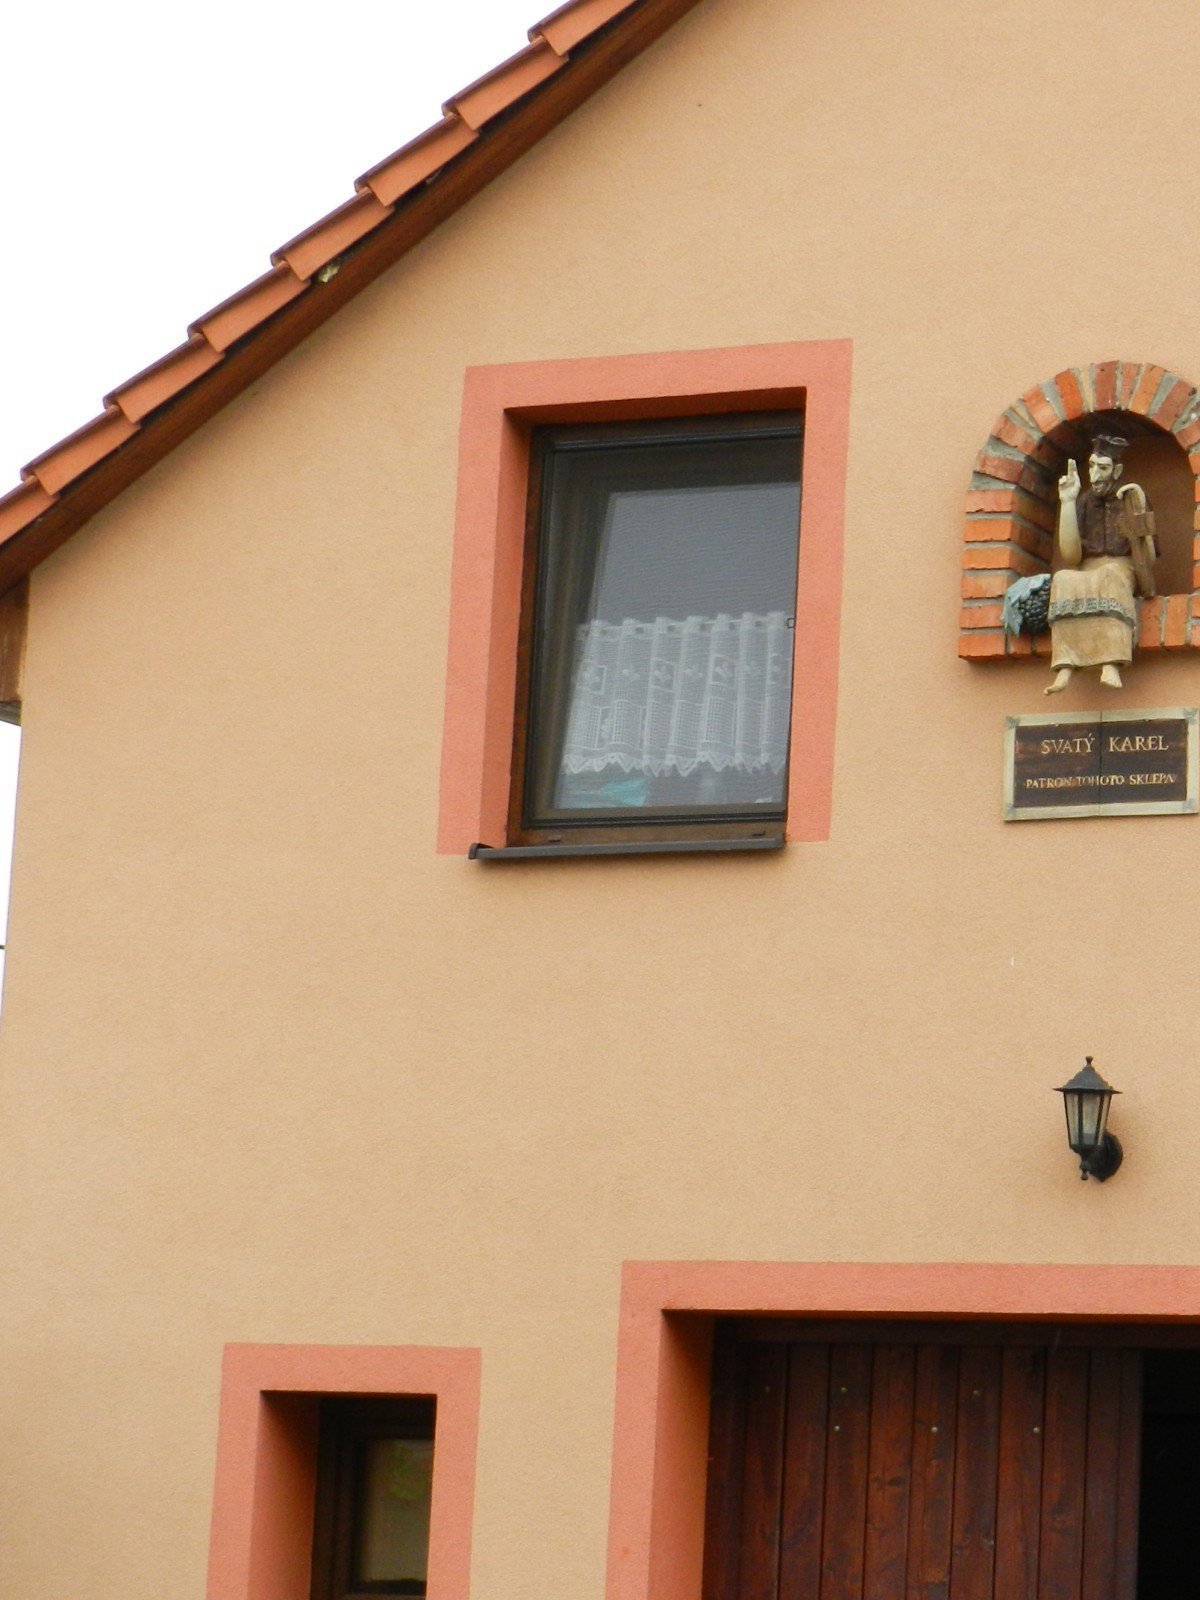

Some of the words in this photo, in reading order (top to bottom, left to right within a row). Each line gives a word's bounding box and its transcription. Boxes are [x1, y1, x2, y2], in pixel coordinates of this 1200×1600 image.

[1041, 733, 1095, 754] SVATÝ
[1109, 735, 1169, 752] KAREL
[1026, 776, 1073, 788] PATRON
[1076, 774, 1125, 787] TOHOTO
[1129, 773, 1175, 785] SKLEPA
